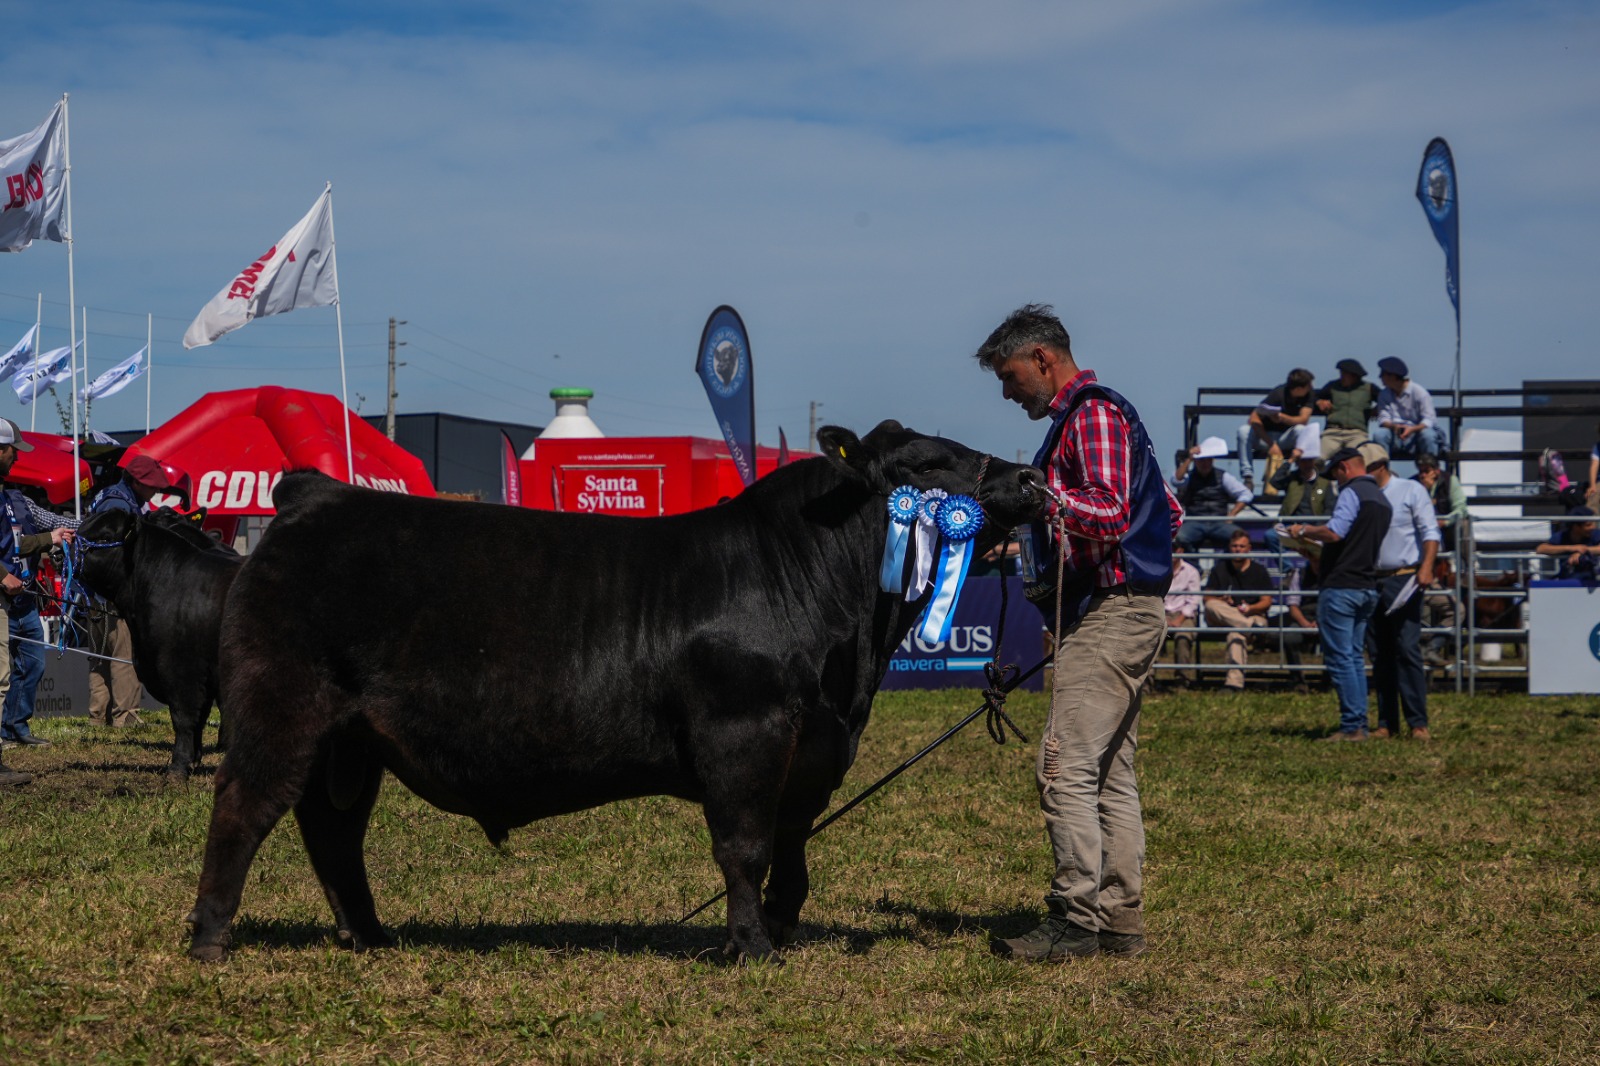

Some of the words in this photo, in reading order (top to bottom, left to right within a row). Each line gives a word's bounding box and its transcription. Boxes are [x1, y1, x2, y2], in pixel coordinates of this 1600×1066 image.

[585, 475, 638, 492] Santa
[577, 491, 645, 513] Sylvina
[894, 622, 993, 653] NGUS
[36, 694, 72, 712] ovincia
